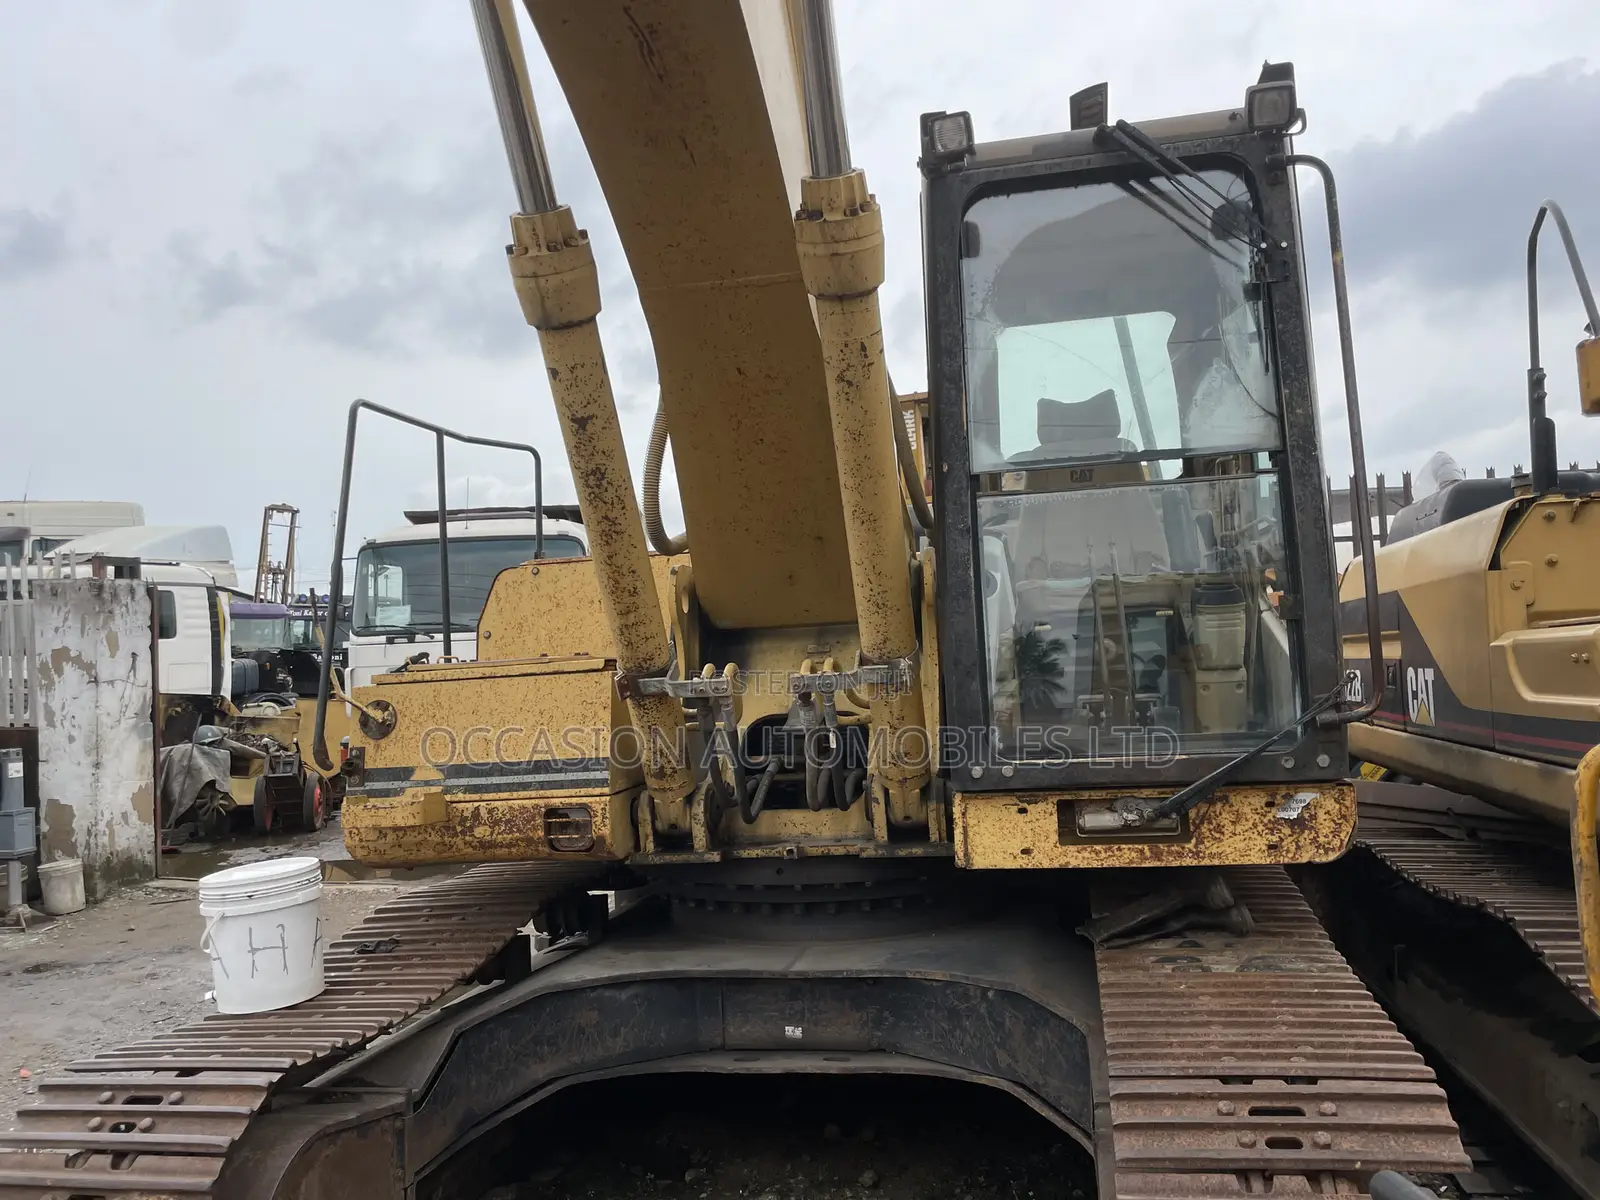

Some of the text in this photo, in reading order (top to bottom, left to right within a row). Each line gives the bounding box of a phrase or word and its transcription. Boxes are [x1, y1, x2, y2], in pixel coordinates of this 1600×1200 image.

[1071, 470, 1093, 482] CAT
[1344, 669, 1362, 702] 22B
[1407, 667, 1435, 727] CAT
